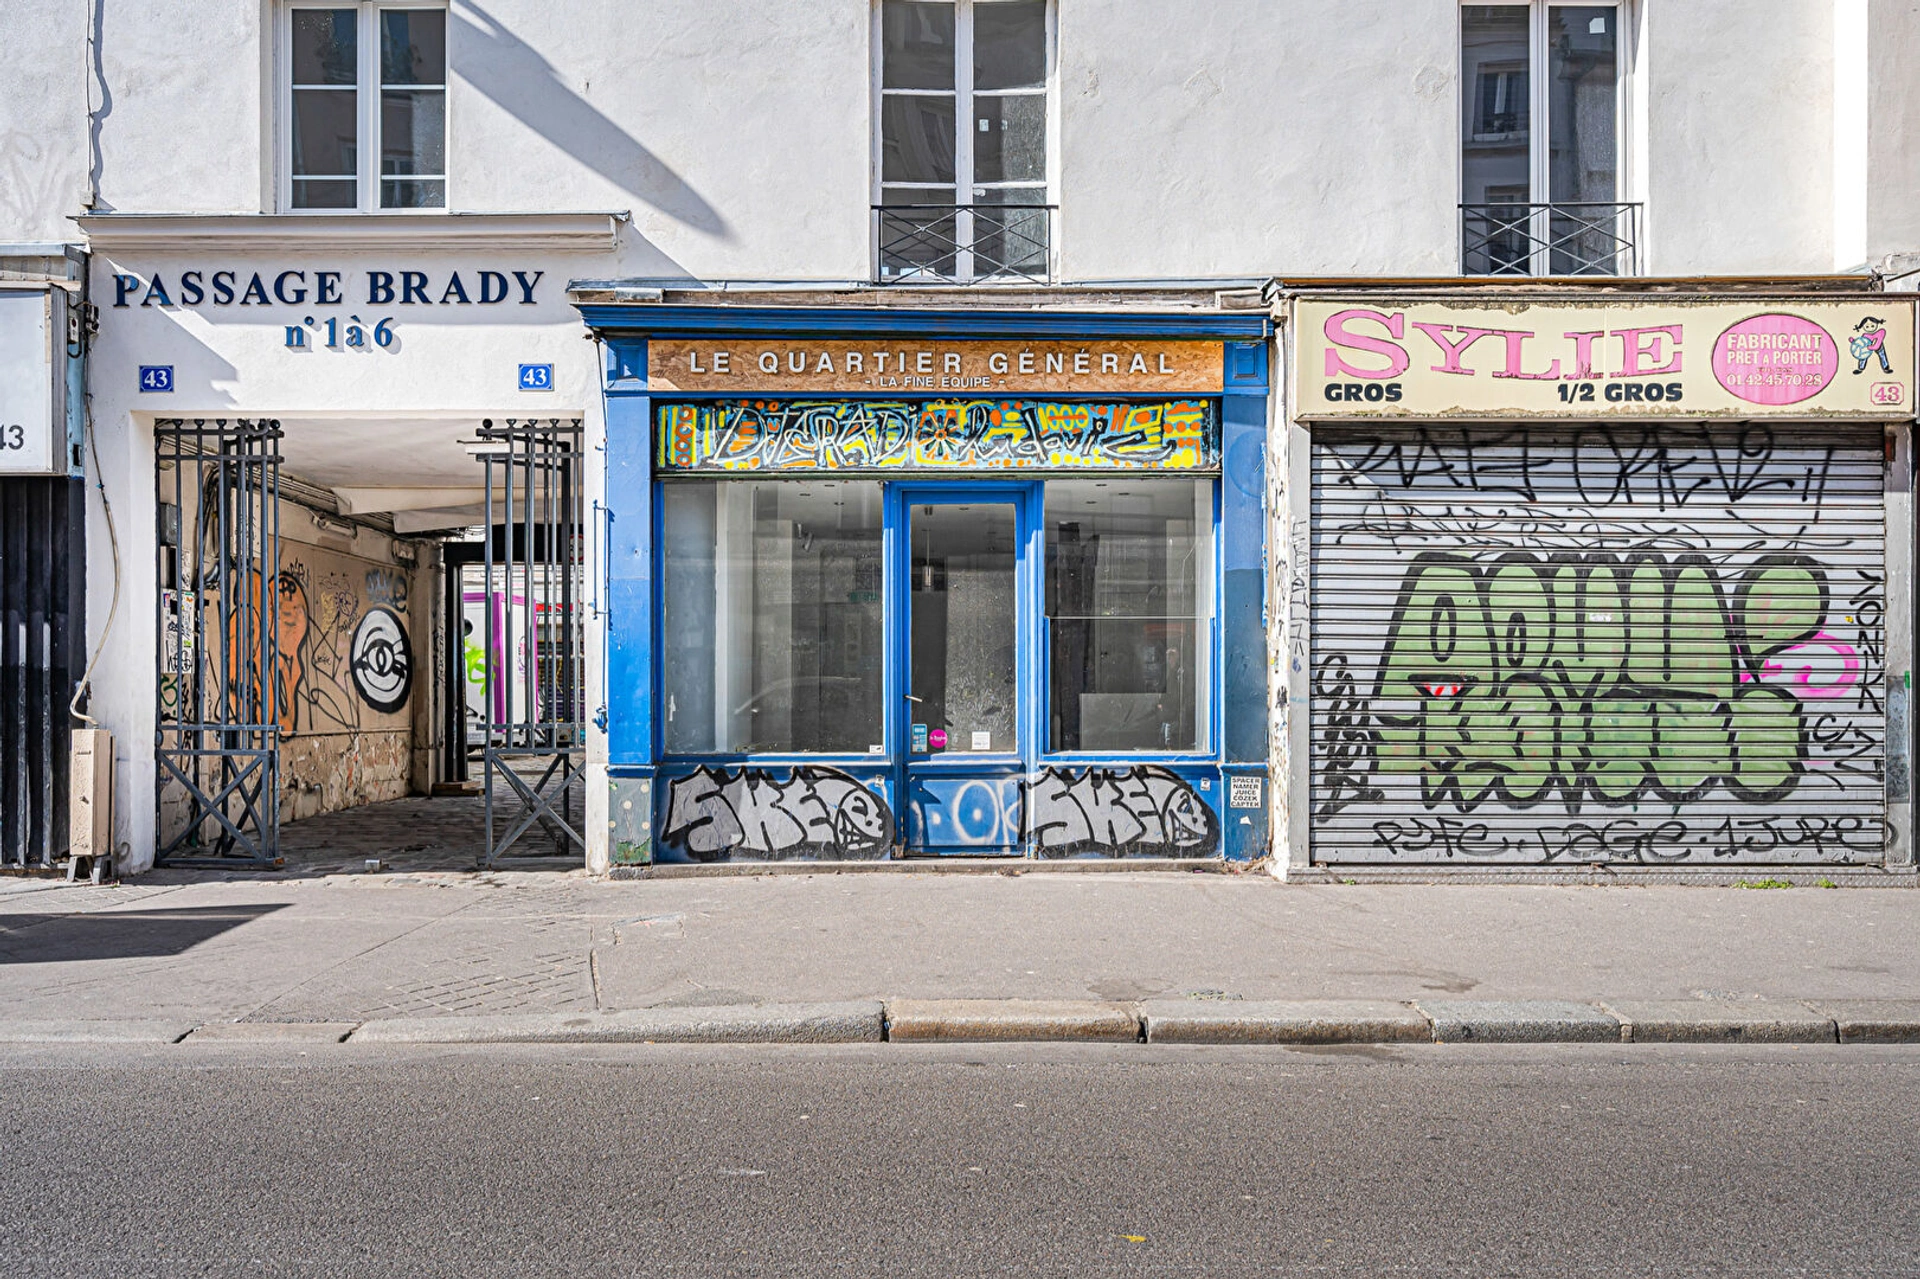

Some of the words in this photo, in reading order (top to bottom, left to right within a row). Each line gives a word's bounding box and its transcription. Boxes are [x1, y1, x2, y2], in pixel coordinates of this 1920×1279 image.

[112, 271, 343, 307] PASSAGE
[366, 271, 544, 305] BRADY
[1324, 309, 1683, 380] SYLIE
[1727, 333, 1823, 349] FABRICANT
[690, 351, 731, 374] LE
[757, 351, 962, 375] QUARTIER
[988, 348, 1174, 374] GÉNÉRAL
[1727, 351, 1759, 365] PRET
[1773, 351, 1823, 365] PORTER
[143, 369, 169, 388] 43
[522, 367, 548, 386] 43
[879, 376, 898, 388] LA
[903, 376, 934, 388] FINE
[1324, 383, 1403, 402] GROS
[1557, 383, 1596, 404] 1/2
[1604, 382, 1684, 403] GROS
[1873, 385, 1901, 402] 43
